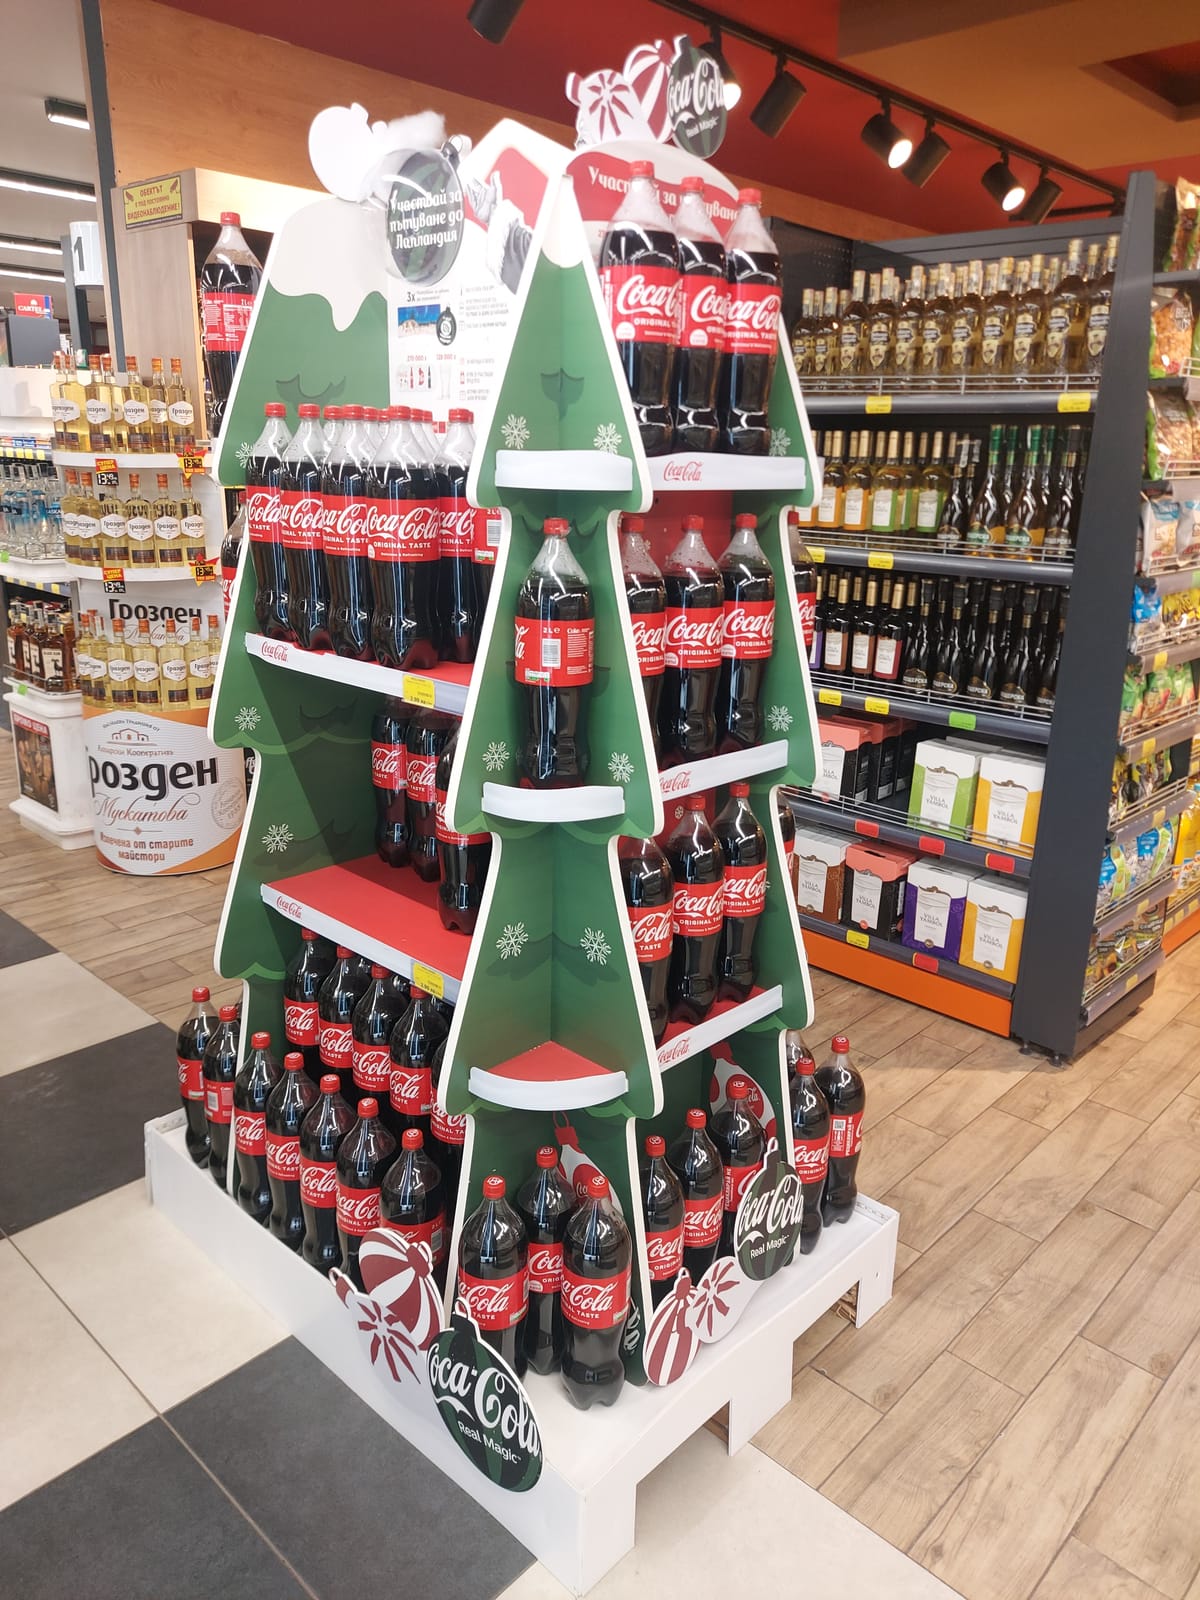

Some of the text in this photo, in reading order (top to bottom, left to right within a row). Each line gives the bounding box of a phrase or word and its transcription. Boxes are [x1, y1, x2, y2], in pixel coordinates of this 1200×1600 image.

[390, 188, 463, 214] Участвай за
[389, 209, 464, 233] пътуване до
[396, 230, 458, 250] Лапландия
[73, 236, 85, 272] 1
[663, 460, 703, 482] Coca-Cola
[367, 505, 439, 540] Coca-Cola
[373, 541, 406, 549] ORIGINAL
[735, 640, 766, 648] ORIGINAL
[677, 648, 711, 656] ORIGINAL
[149, 838, 194, 850] старите
[680, 918, 712, 927] ORIGINAL
[639, 943, 661, 951] TASTE
[325, 1050, 343, 1059] TASTE
[306, 1190, 325, 1199] TASTE
[750, 1243, 765, 1259] Real
[473, 1311, 496, 1320] TASTE
[576, 1310, 600, 1319] TASTE
[428, 1343, 541, 1457] Coca-Cola
[457, 1420, 481, 1442] Real
